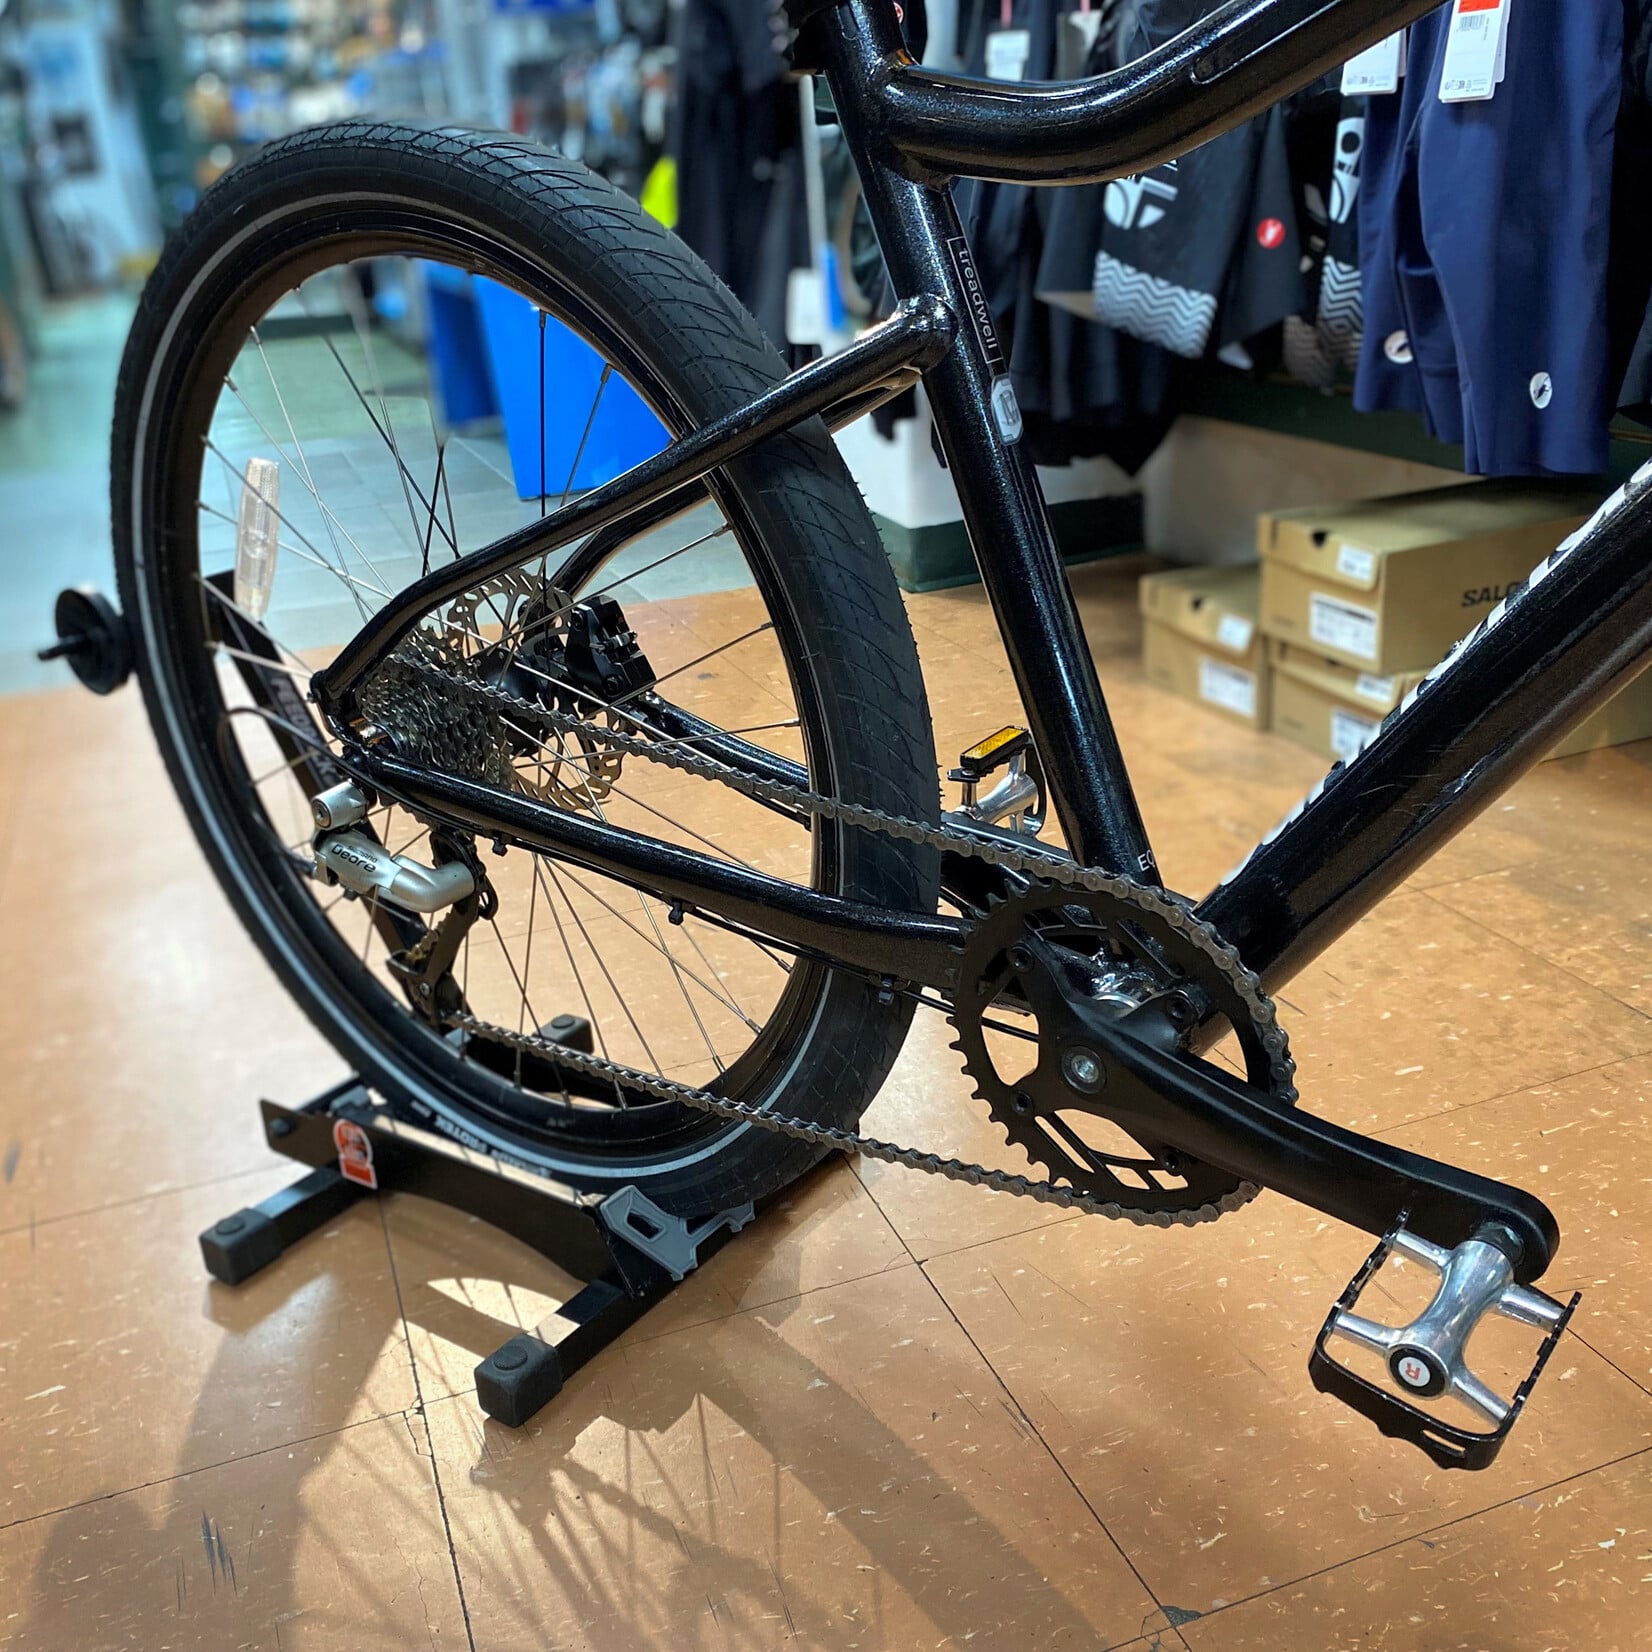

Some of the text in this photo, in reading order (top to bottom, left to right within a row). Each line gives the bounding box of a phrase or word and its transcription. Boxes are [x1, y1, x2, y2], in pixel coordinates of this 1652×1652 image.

[958, 248, 997, 350] treadwell
[331, 843, 377, 873] Deore
[1405, 1362, 1421, 1381] R
